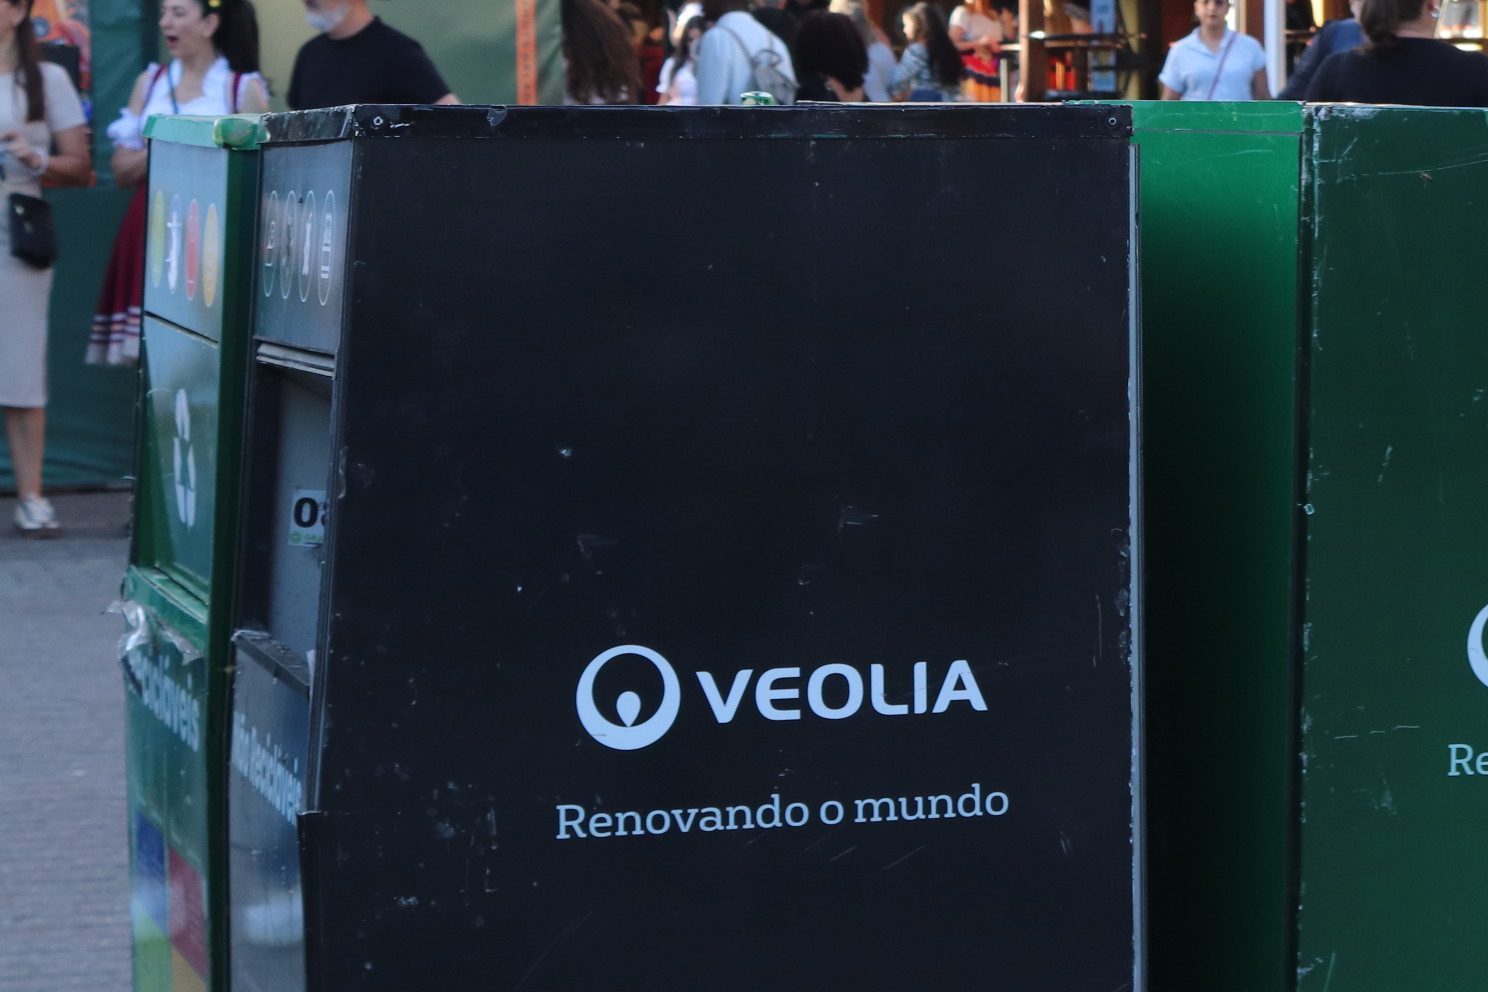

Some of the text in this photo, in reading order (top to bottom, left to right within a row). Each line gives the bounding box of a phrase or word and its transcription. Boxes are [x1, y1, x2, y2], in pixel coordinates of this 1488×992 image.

[293, 497, 326, 528] 0
[696, 659, 988, 724] VEOLIA
[556, 783, 1009, 839] Renovando o mundo
